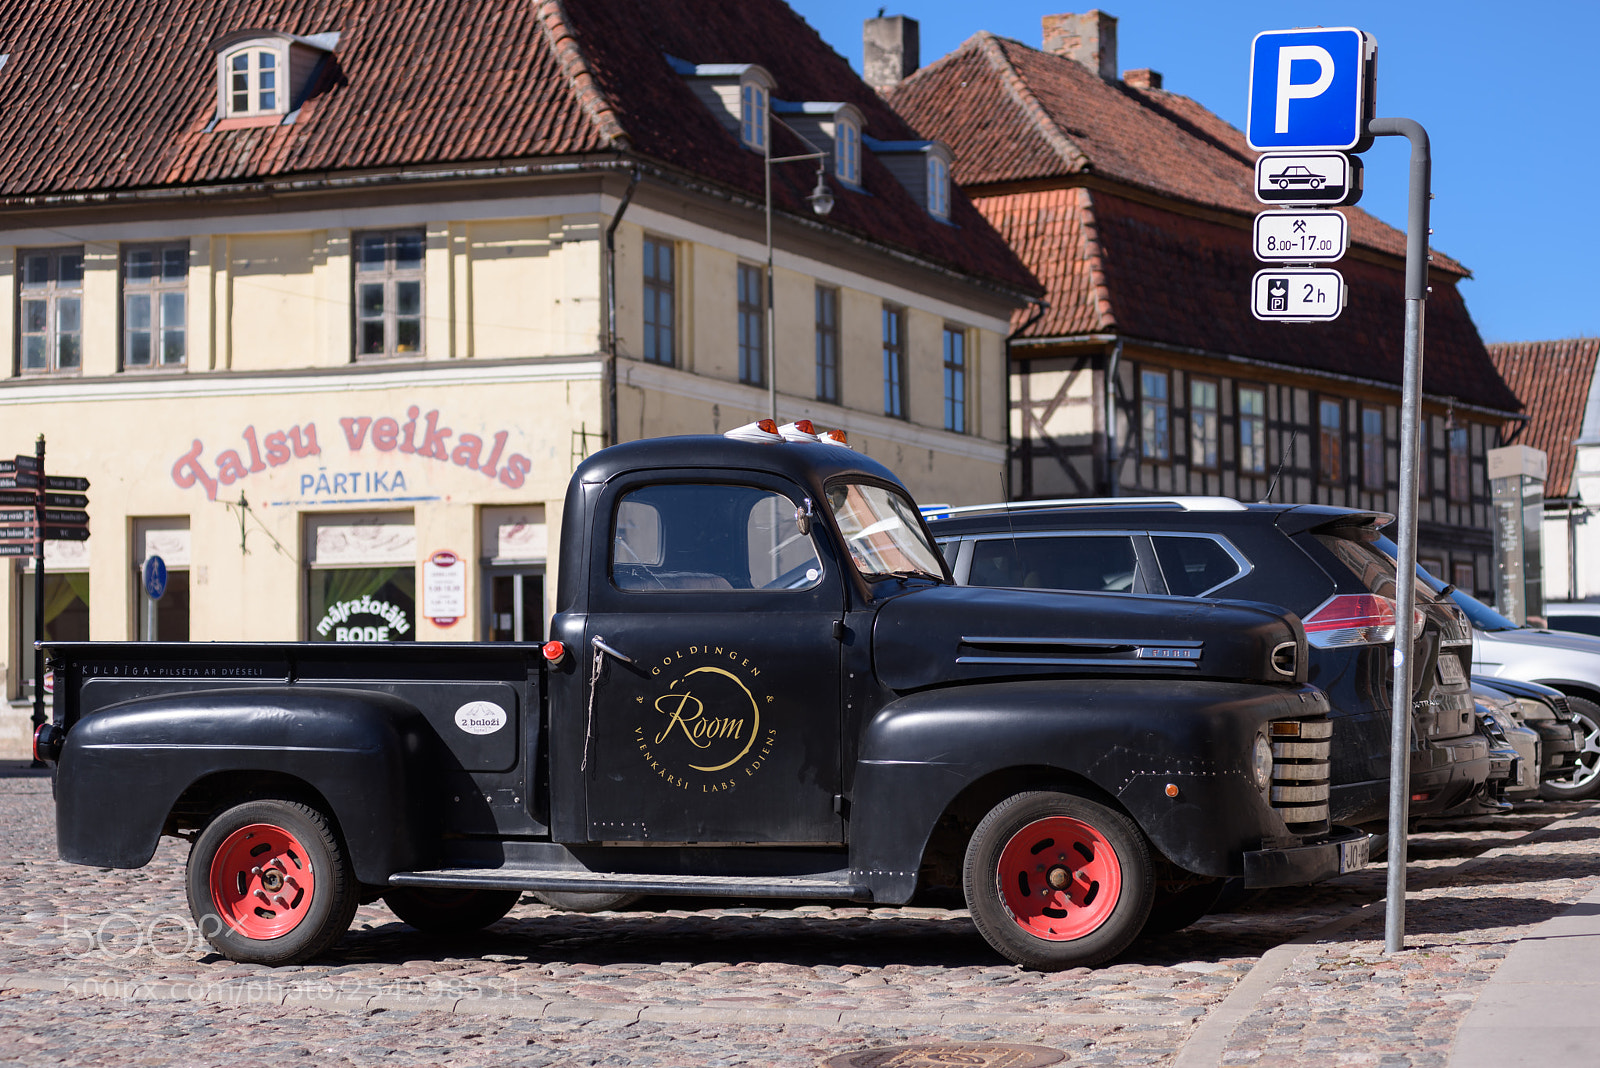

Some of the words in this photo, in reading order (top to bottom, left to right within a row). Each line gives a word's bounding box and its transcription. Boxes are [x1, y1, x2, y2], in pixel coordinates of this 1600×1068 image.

[1275, 45, 1335, 134] P
[1267, 235, 1332, 251] 8.00-17.00
[171, 422, 322, 501] Talsu
[339, 404, 532, 490] veikals
[300, 467, 407, 496] PĀRTIKA
[82, 664, 150, 675] KULDĪGA
[159, 667, 199, 676] PILSĒTA
[204, 668, 216, 676] AR
[221, 667, 263, 676] DVĒSELI
[651, 645, 761, 677] GOLDINGEN
[461, 718, 468, 727] 2
[654, 691, 744, 748] Room
[634, 726, 689, 790] VIENKĀRŠI
[703, 778, 736, 793] LABS
[745, 728, 777, 777] ĒDIENS
